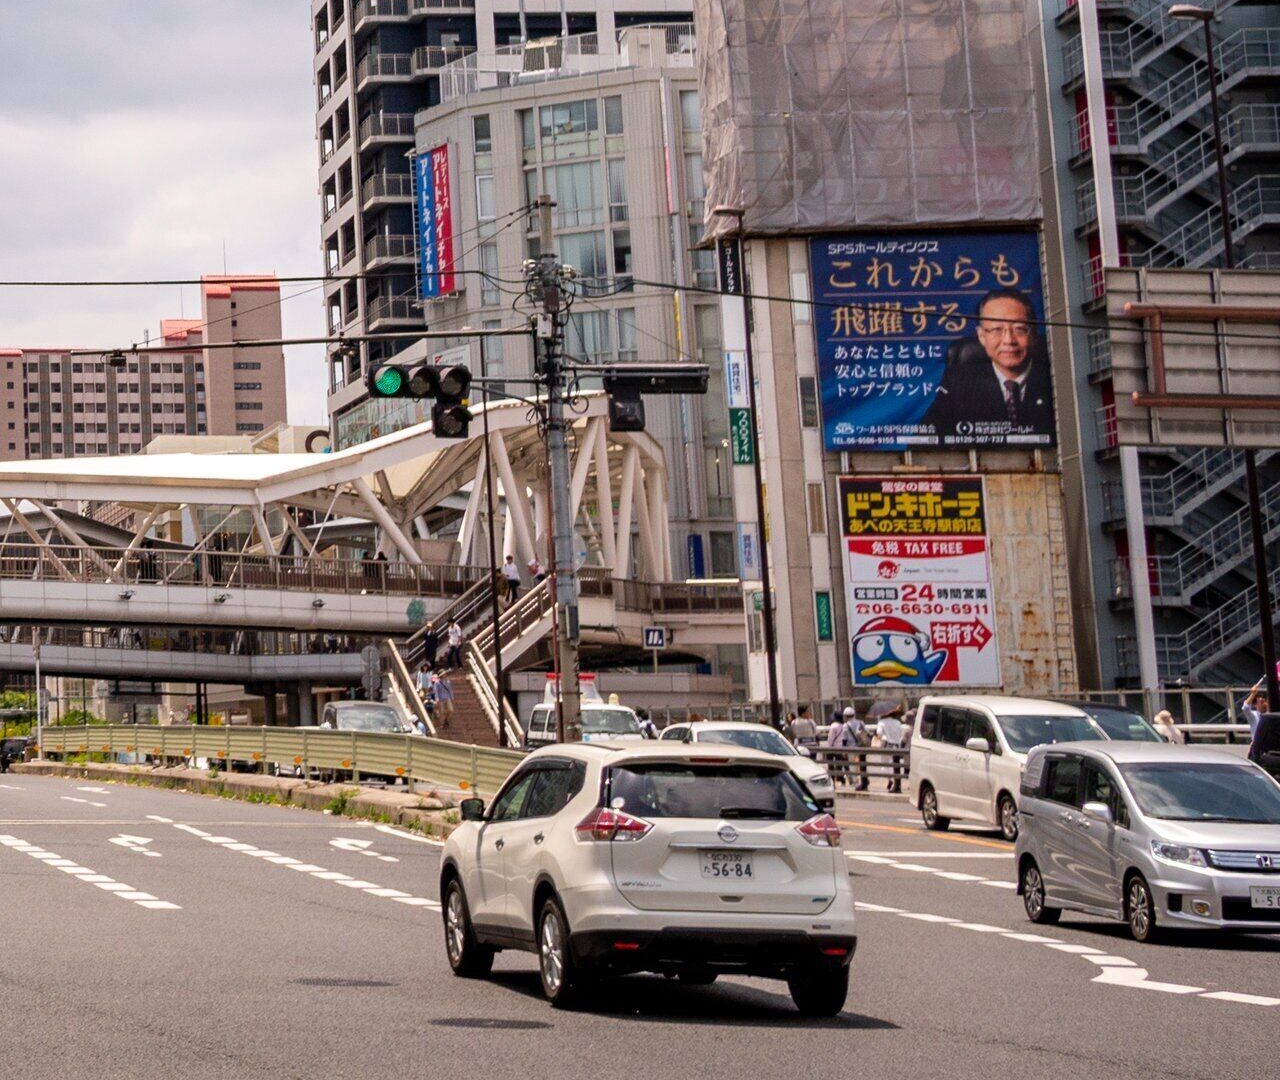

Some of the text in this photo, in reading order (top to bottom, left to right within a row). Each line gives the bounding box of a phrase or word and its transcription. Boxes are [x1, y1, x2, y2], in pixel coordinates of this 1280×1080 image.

[440, 151, 449, 209] レディース
[420, 158, 433, 292] アートネイチャー
[432, 152, 446, 288] アートネイチャー
[827, 240, 939, 255] SPSホールディングス
[829, 254, 1020, 289] これからも
[831, 300, 967, 336] 飛躍する
[834, 344, 943, 360] あなたとともに
[834, 363, 923, 379] 安心と信頼の
[836, 381, 950, 398] トップブランドへ
[849, 518, 982, 533] あべの天王寺駅前店
[871, 542, 963, 554] 免税 TAX FREE
[901, 584, 934, 602] 24
[937, 588, 987, 599] 時間営業
[872, 603, 989, 615] 06-6630-6911
[932, 623, 986, 645] 右折すぐ
[712, 863, 752, 877] 56-84
